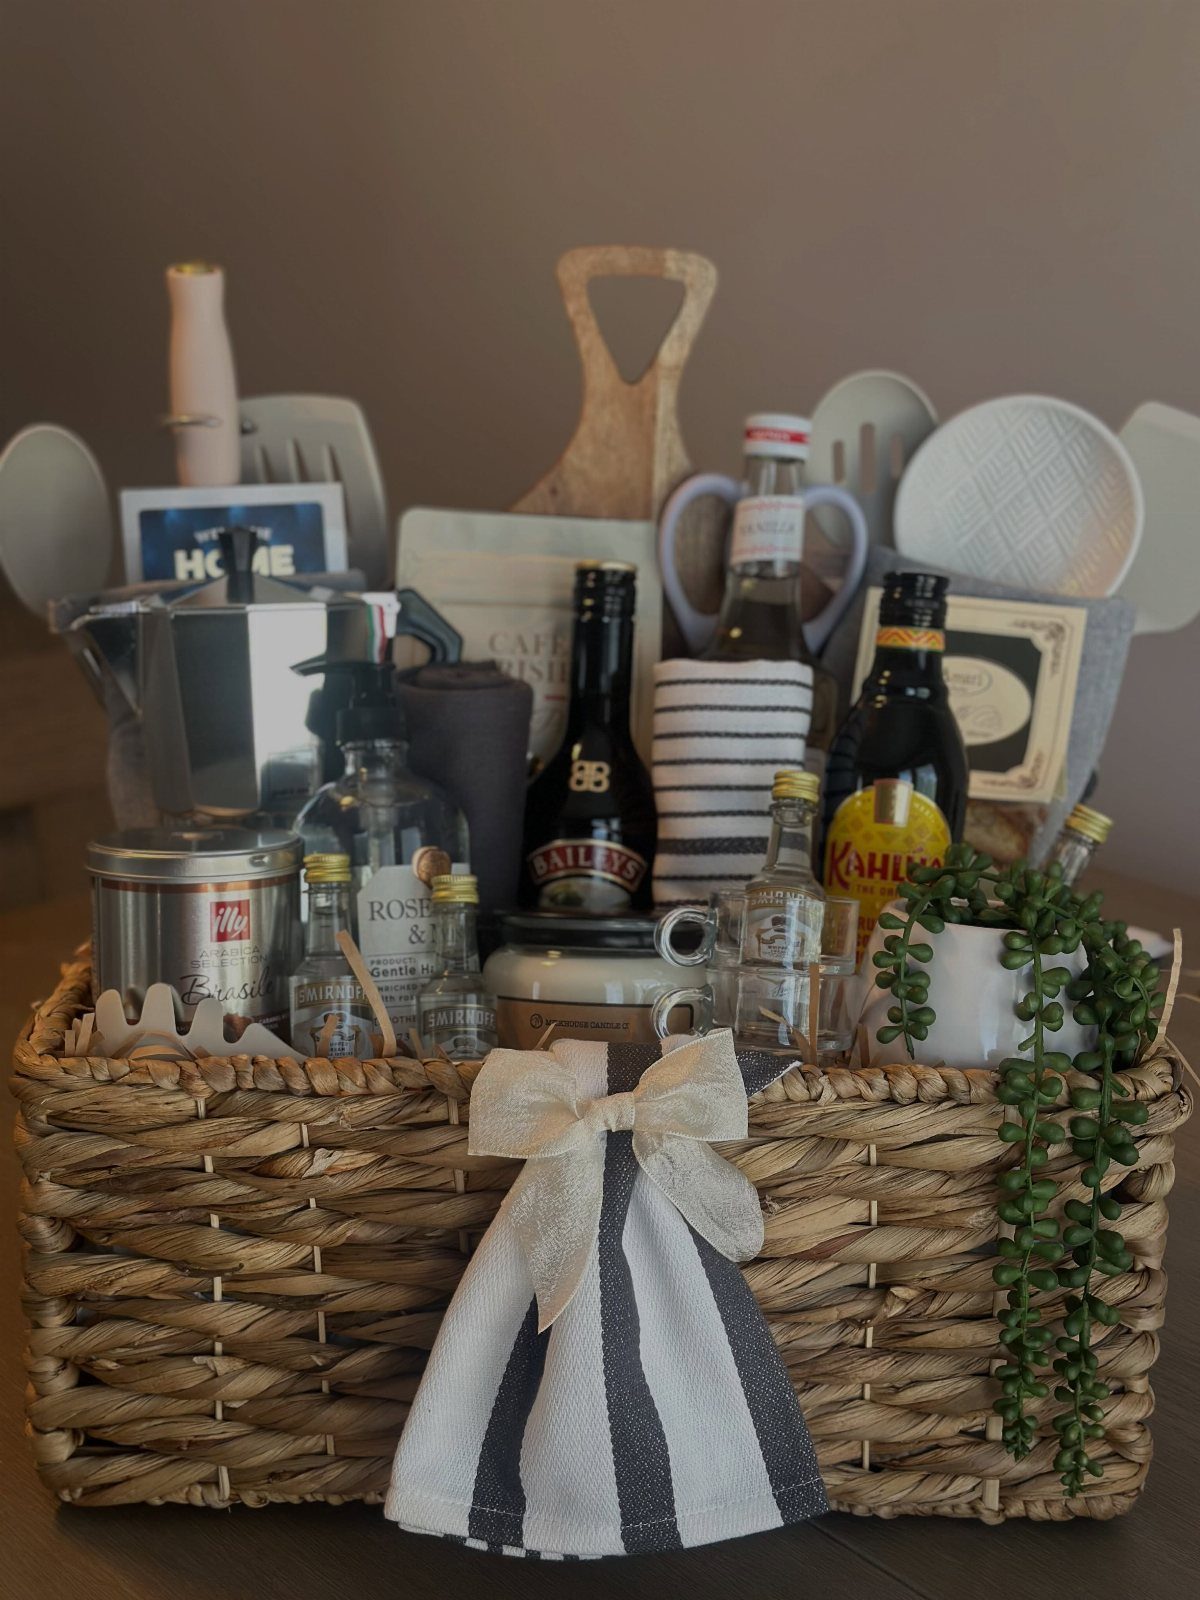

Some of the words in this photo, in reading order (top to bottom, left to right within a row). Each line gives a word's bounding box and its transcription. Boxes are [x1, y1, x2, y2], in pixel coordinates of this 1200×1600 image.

[532, 846, 641, 881] BAILEYS
[368, 897, 432, 921] ROSE
[214, 906, 248, 938] illy
[200, 945, 260, 958] ARABICA
[190, 954, 269, 969] SELECTION
[371, 964, 417, 978] Gentle
[298, 983, 368, 1004] SMIRNOF
[377, 983, 418, 993] NRICHED
[428, 1008, 496, 1029] SMIRNOFF
[590, 1021, 621, 1029] CANDLE
